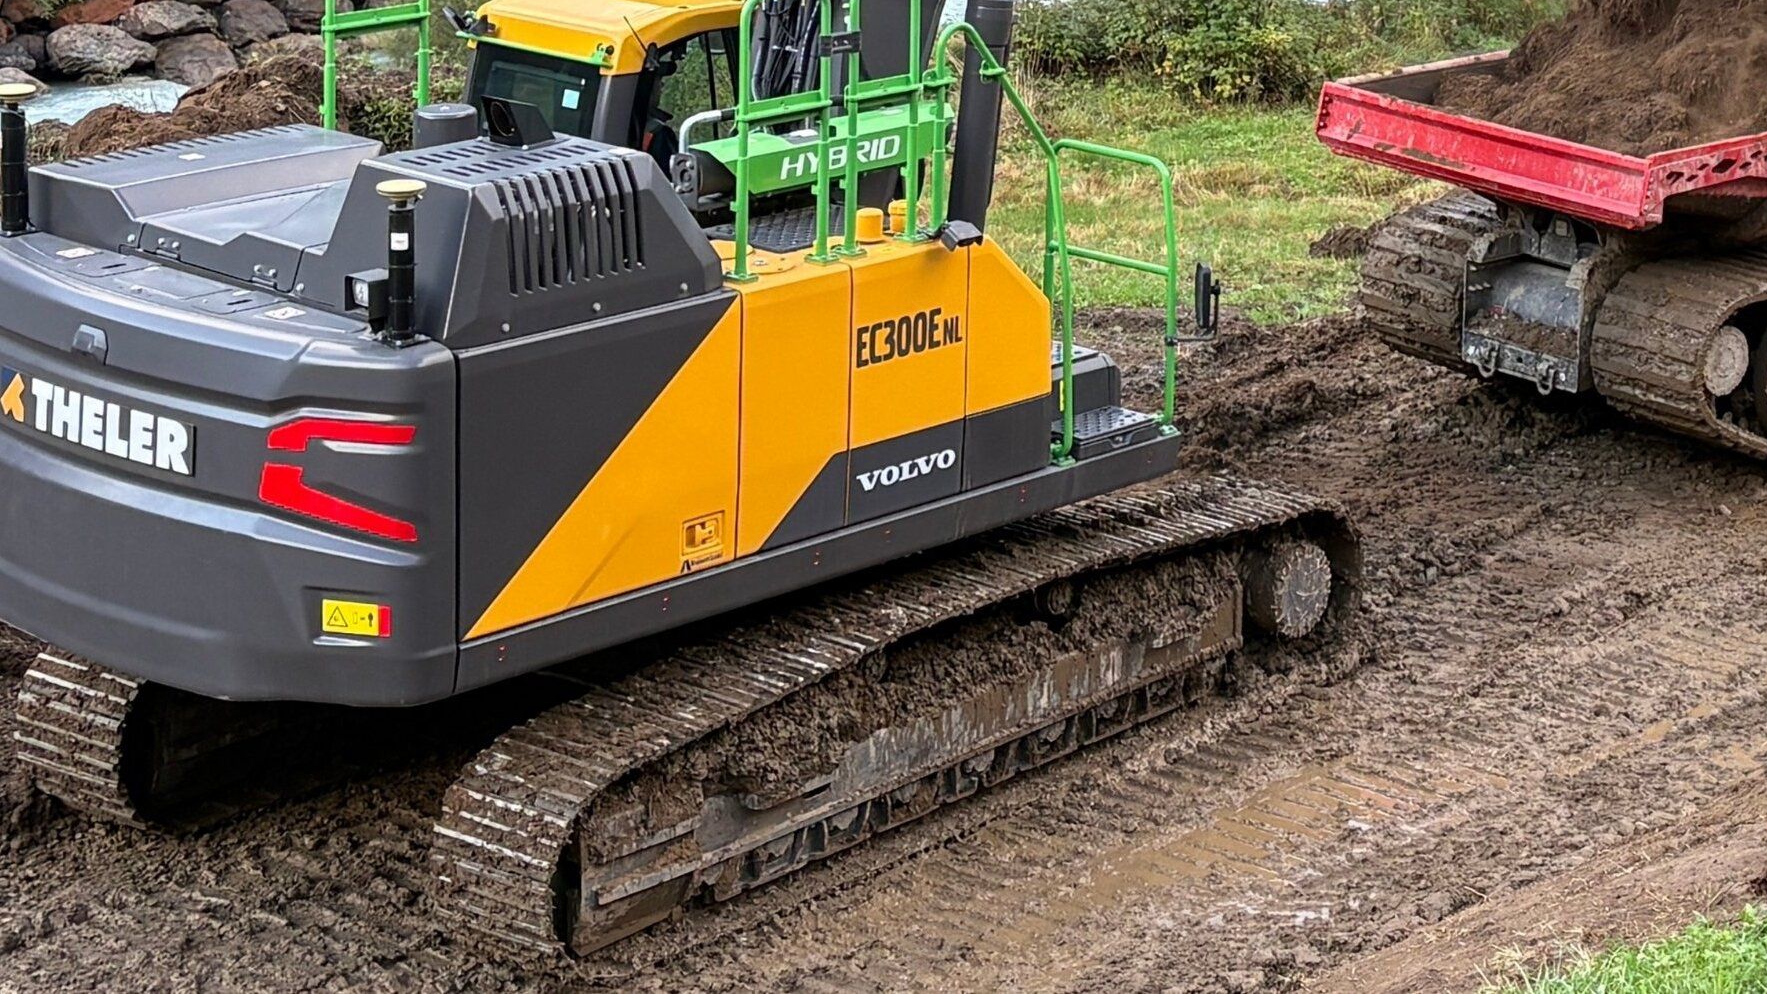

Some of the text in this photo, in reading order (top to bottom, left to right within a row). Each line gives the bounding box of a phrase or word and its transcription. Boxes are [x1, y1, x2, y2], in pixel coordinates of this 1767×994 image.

[780, 134, 901, 180] HYBRID
[31, 378, 192, 476] THELER
[856, 449, 956, 492] VOLVO
